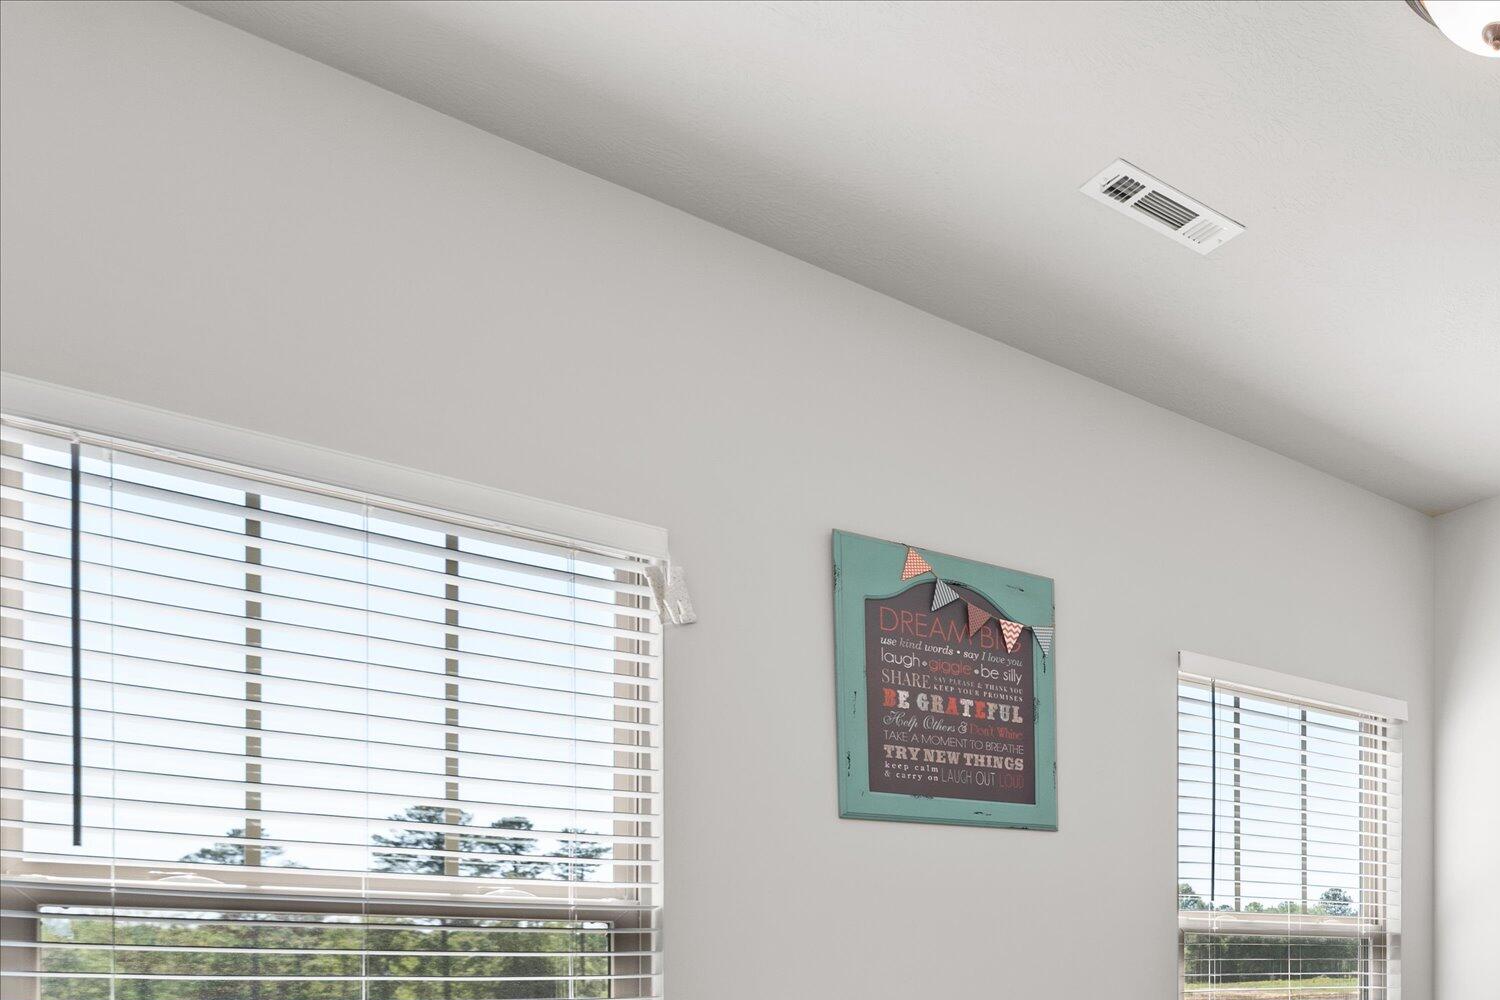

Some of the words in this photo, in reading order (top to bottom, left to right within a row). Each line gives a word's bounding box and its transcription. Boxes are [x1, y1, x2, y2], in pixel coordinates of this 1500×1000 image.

[880, 607, 972, 646] DREAM
[880, 637, 897, 646] use
[900, 638, 922, 650] kind
[924, 644, 953, 656] words
[963, 651, 979, 660] say
[981, 652, 986, 660] I
[988, 653, 1005, 663] love
[1006, 659, 1023, 667] you
[881, 647, 920, 668] laugh
[929, 660, 970, 676] giggle
[981, 664, 999, 679] be
[1003, 668, 1022, 685] silly
[881, 668, 931, 689] SHARE
[882, 687, 910, 709] BE
[916, 692, 1023, 723] GRATEFUL
[957, 687, 980, 696] YOUR
[983, 691, 1023, 702] PROMISES
[883, 710, 918, 732] Help
[923, 714, 955, 732] Others
[958, 721, 968, 734] &
[883, 729, 908, 742] TAKE
[911, 733, 920, 743] A
[920, 734, 968, 748] MOMENT
[970, 739, 983, 750] TO
[985, 741, 1024, 755] BREATHE
[883, 744, 920, 760] TRY
[923, 748, 960, 765] NEW
[963, 752, 1024, 771] THINGS
[884, 761, 909, 771] keep
[915, 764, 938, 772] calm
[896, 772, 922, 781] carry
[941, 767, 972, 784] LAUGH
[975, 770, 995, 787] OUT
[1000, 773, 1024, 788] LOUD
